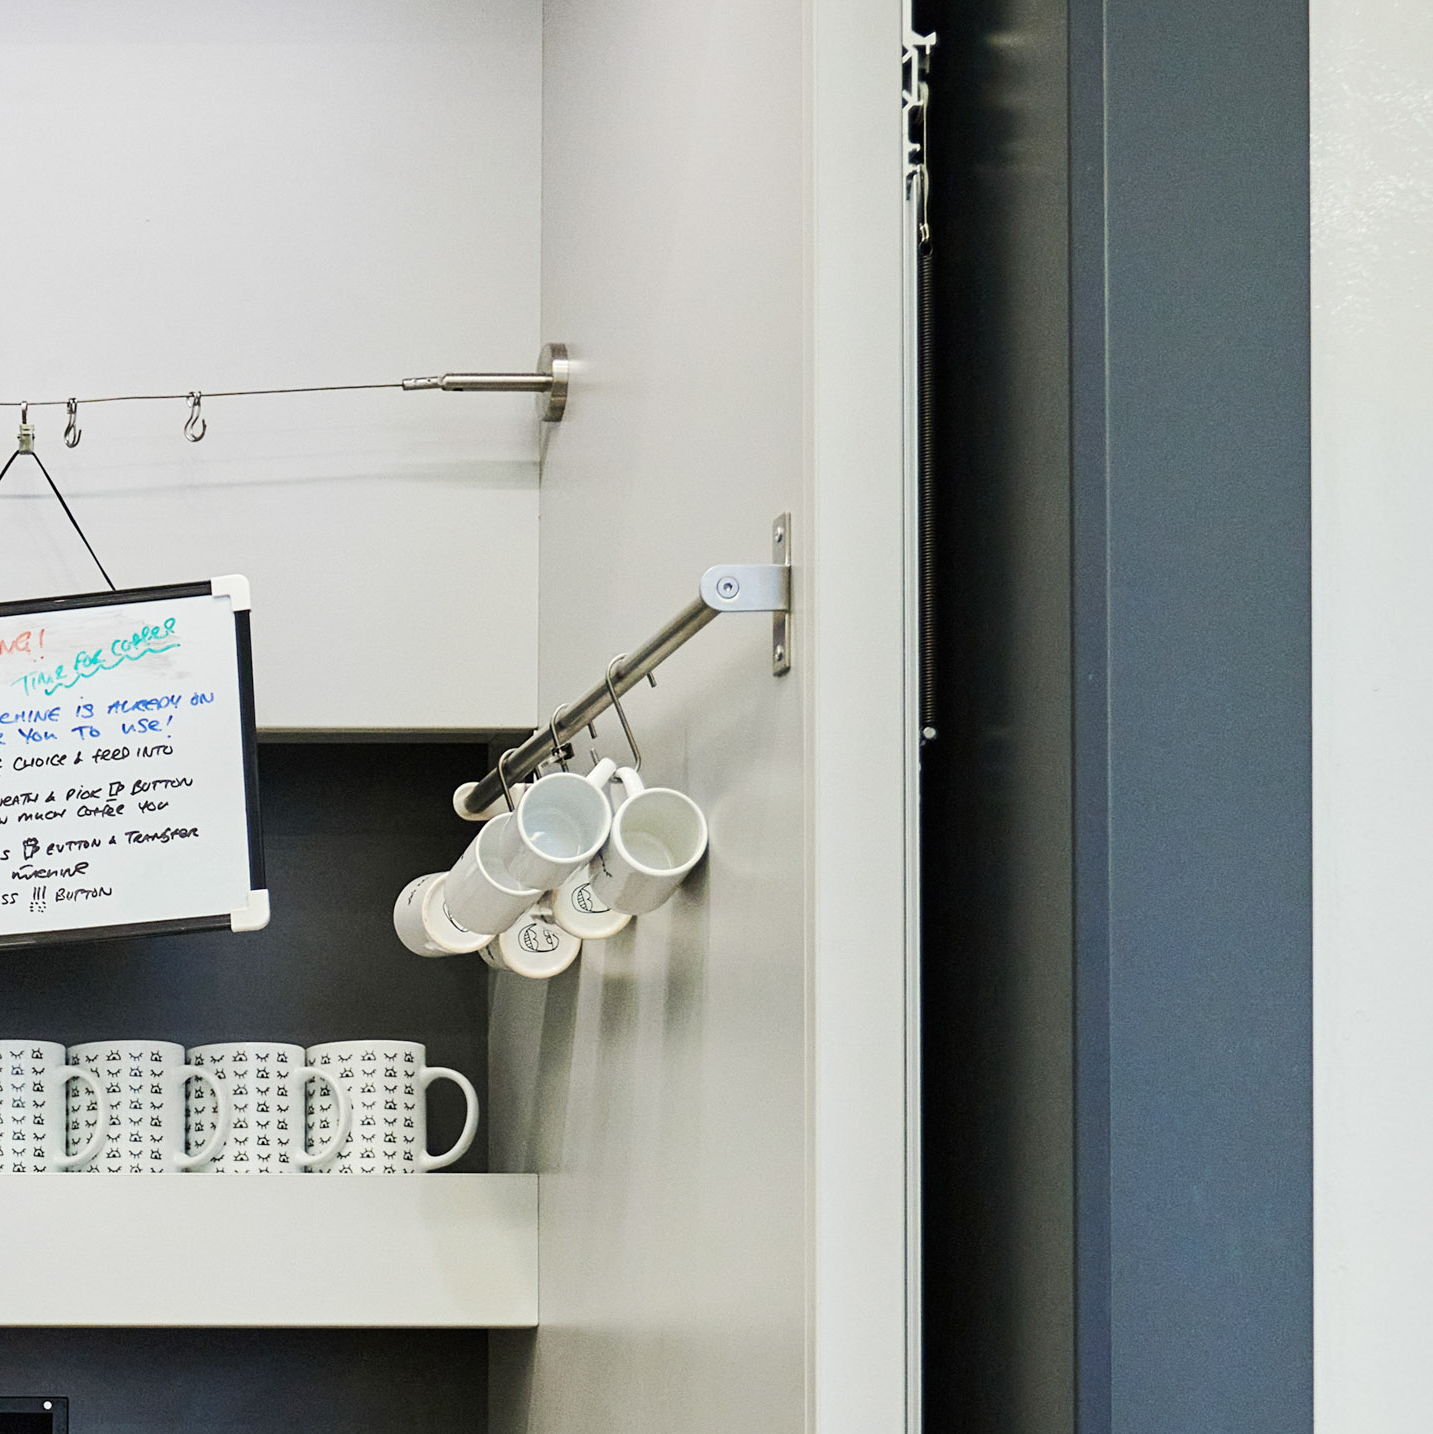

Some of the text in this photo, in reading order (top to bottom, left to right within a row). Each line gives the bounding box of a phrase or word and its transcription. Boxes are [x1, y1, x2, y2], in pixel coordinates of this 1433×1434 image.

[75, 695, 95, 719] IS
[18, 727, 59, 745] YOU
[70, 725, 101, 741] TO
[136, 744, 174, 759] INTO
[129, 777, 194, 796] BUTTON
[138, 799, 170, 815] YOU
[54, 886, 114, 903] BUTTON
